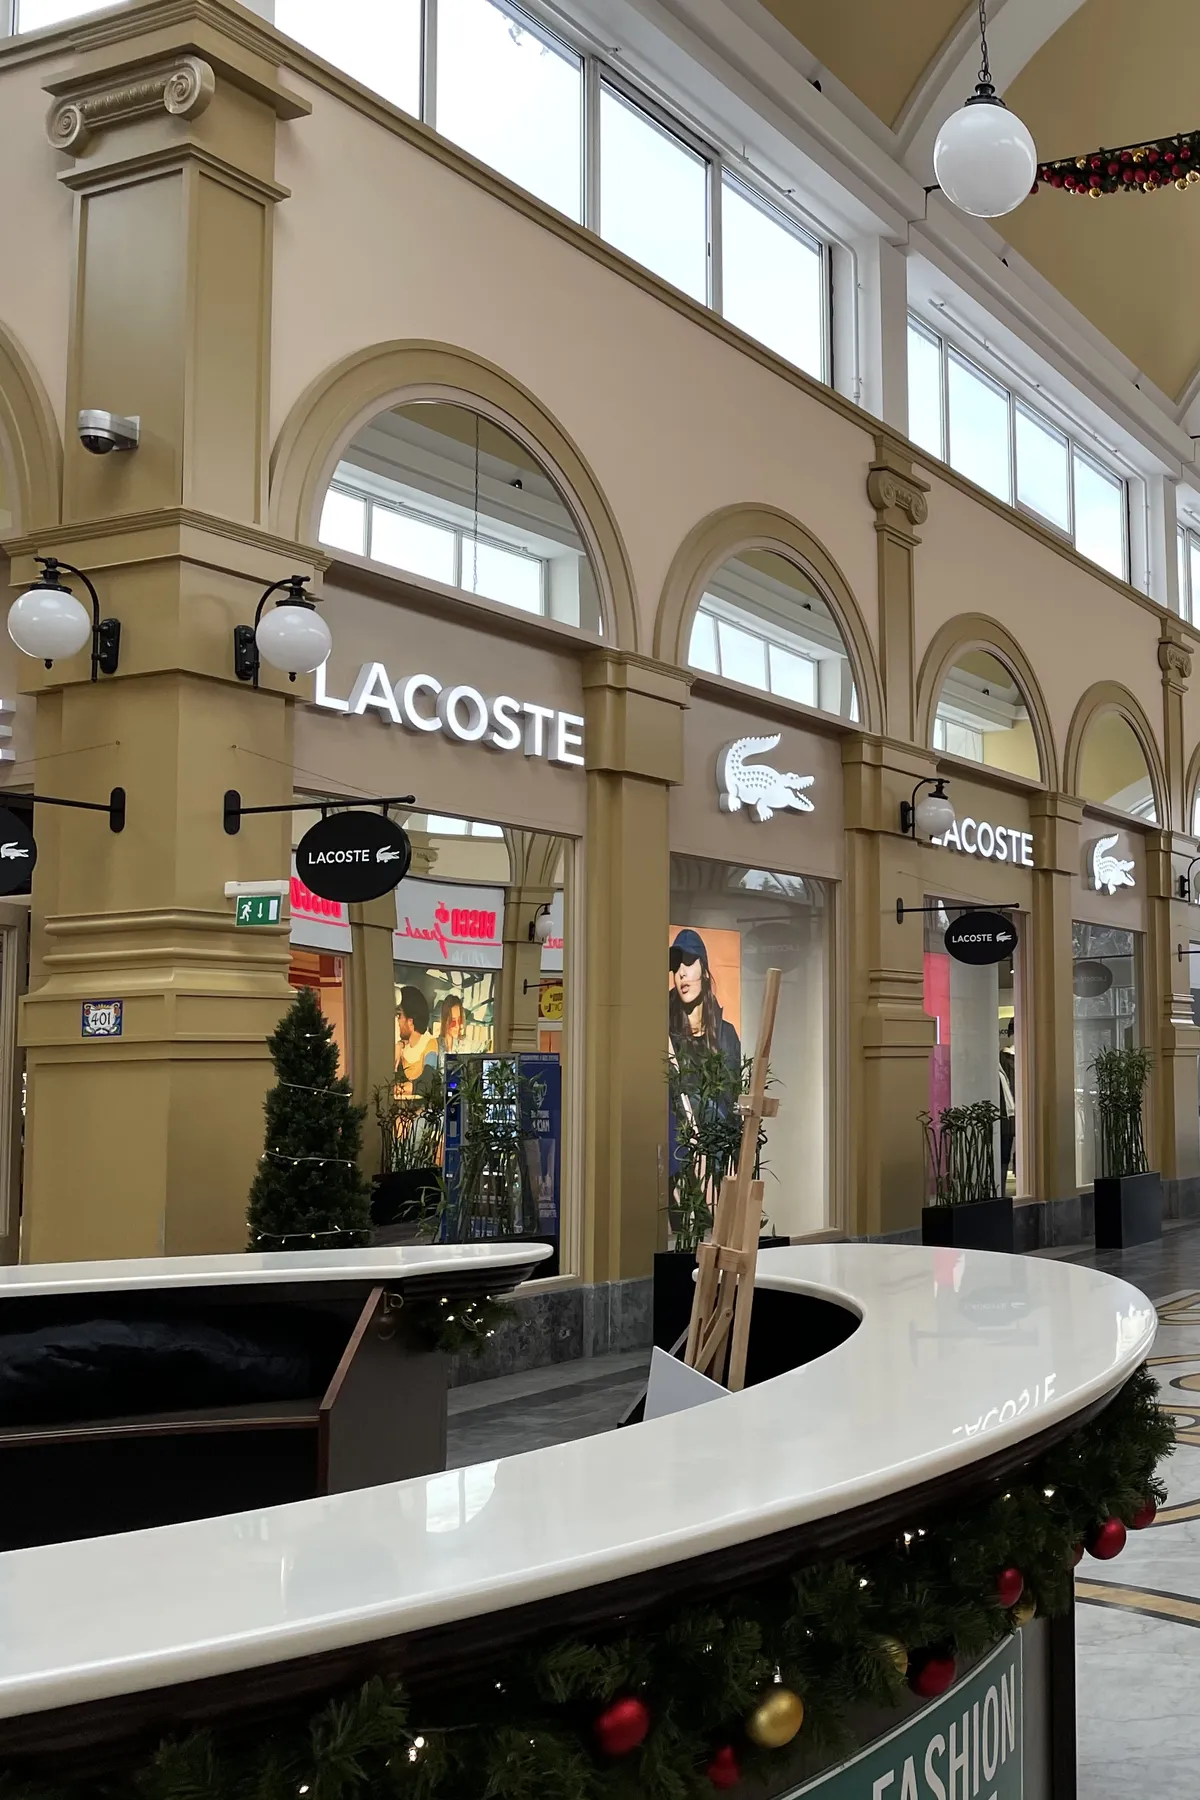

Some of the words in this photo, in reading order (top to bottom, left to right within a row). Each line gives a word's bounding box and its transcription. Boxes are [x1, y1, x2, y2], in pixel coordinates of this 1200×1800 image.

[315, 660, 585, 766] LACOSTE
[308, 849, 370, 865] LACOSTE
[952, 933, 993, 943] LACOSTE
[91, 1012, 111, 1026] 401
